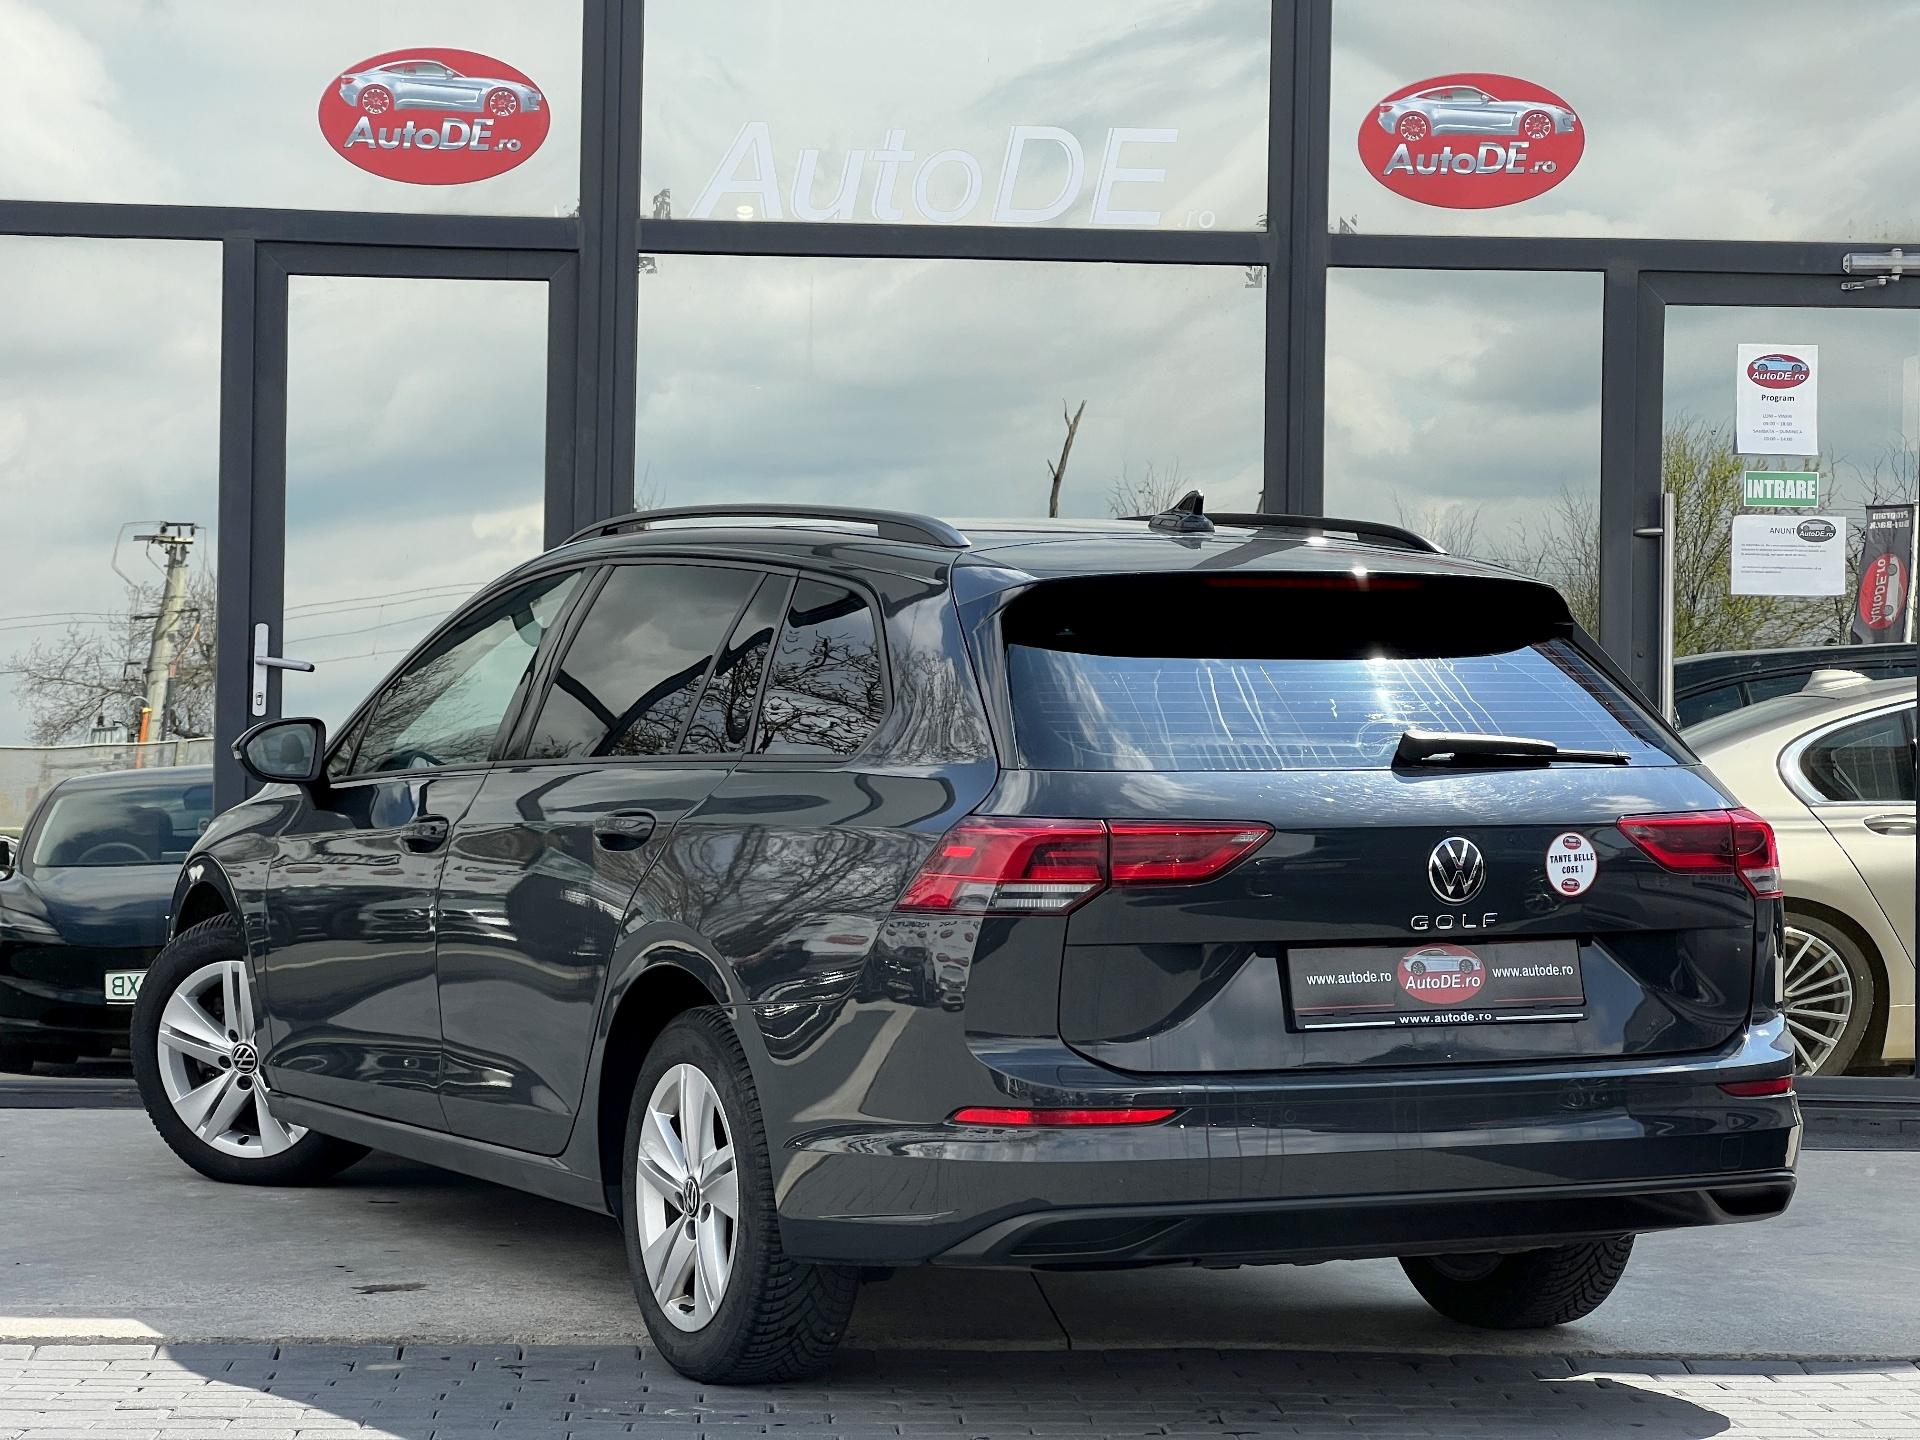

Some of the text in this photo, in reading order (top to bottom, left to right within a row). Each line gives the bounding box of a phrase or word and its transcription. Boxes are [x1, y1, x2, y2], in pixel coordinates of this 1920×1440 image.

[1751, 371, 1806, 381] AutoDE.ro
[1761, 394, 1795, 402] Program
[1747, 479, 1816, 499] INTRARE
[1769, 527, 1796, 535] ANUNT
[1549, 852, 1594, 864] TANTE BELLE
[1561, 865, 1579, 874] COSE
[1410, 912, 1498, 930] GOLF
[1306, 971, 1392, 985] www.autode.ro
[1492, 964, 1574, 978] www.autode.ro
[1405, 974, 1481, 990] AutoDE.ro
[1399, 1011, 1492, 1025] www.autode.ro
